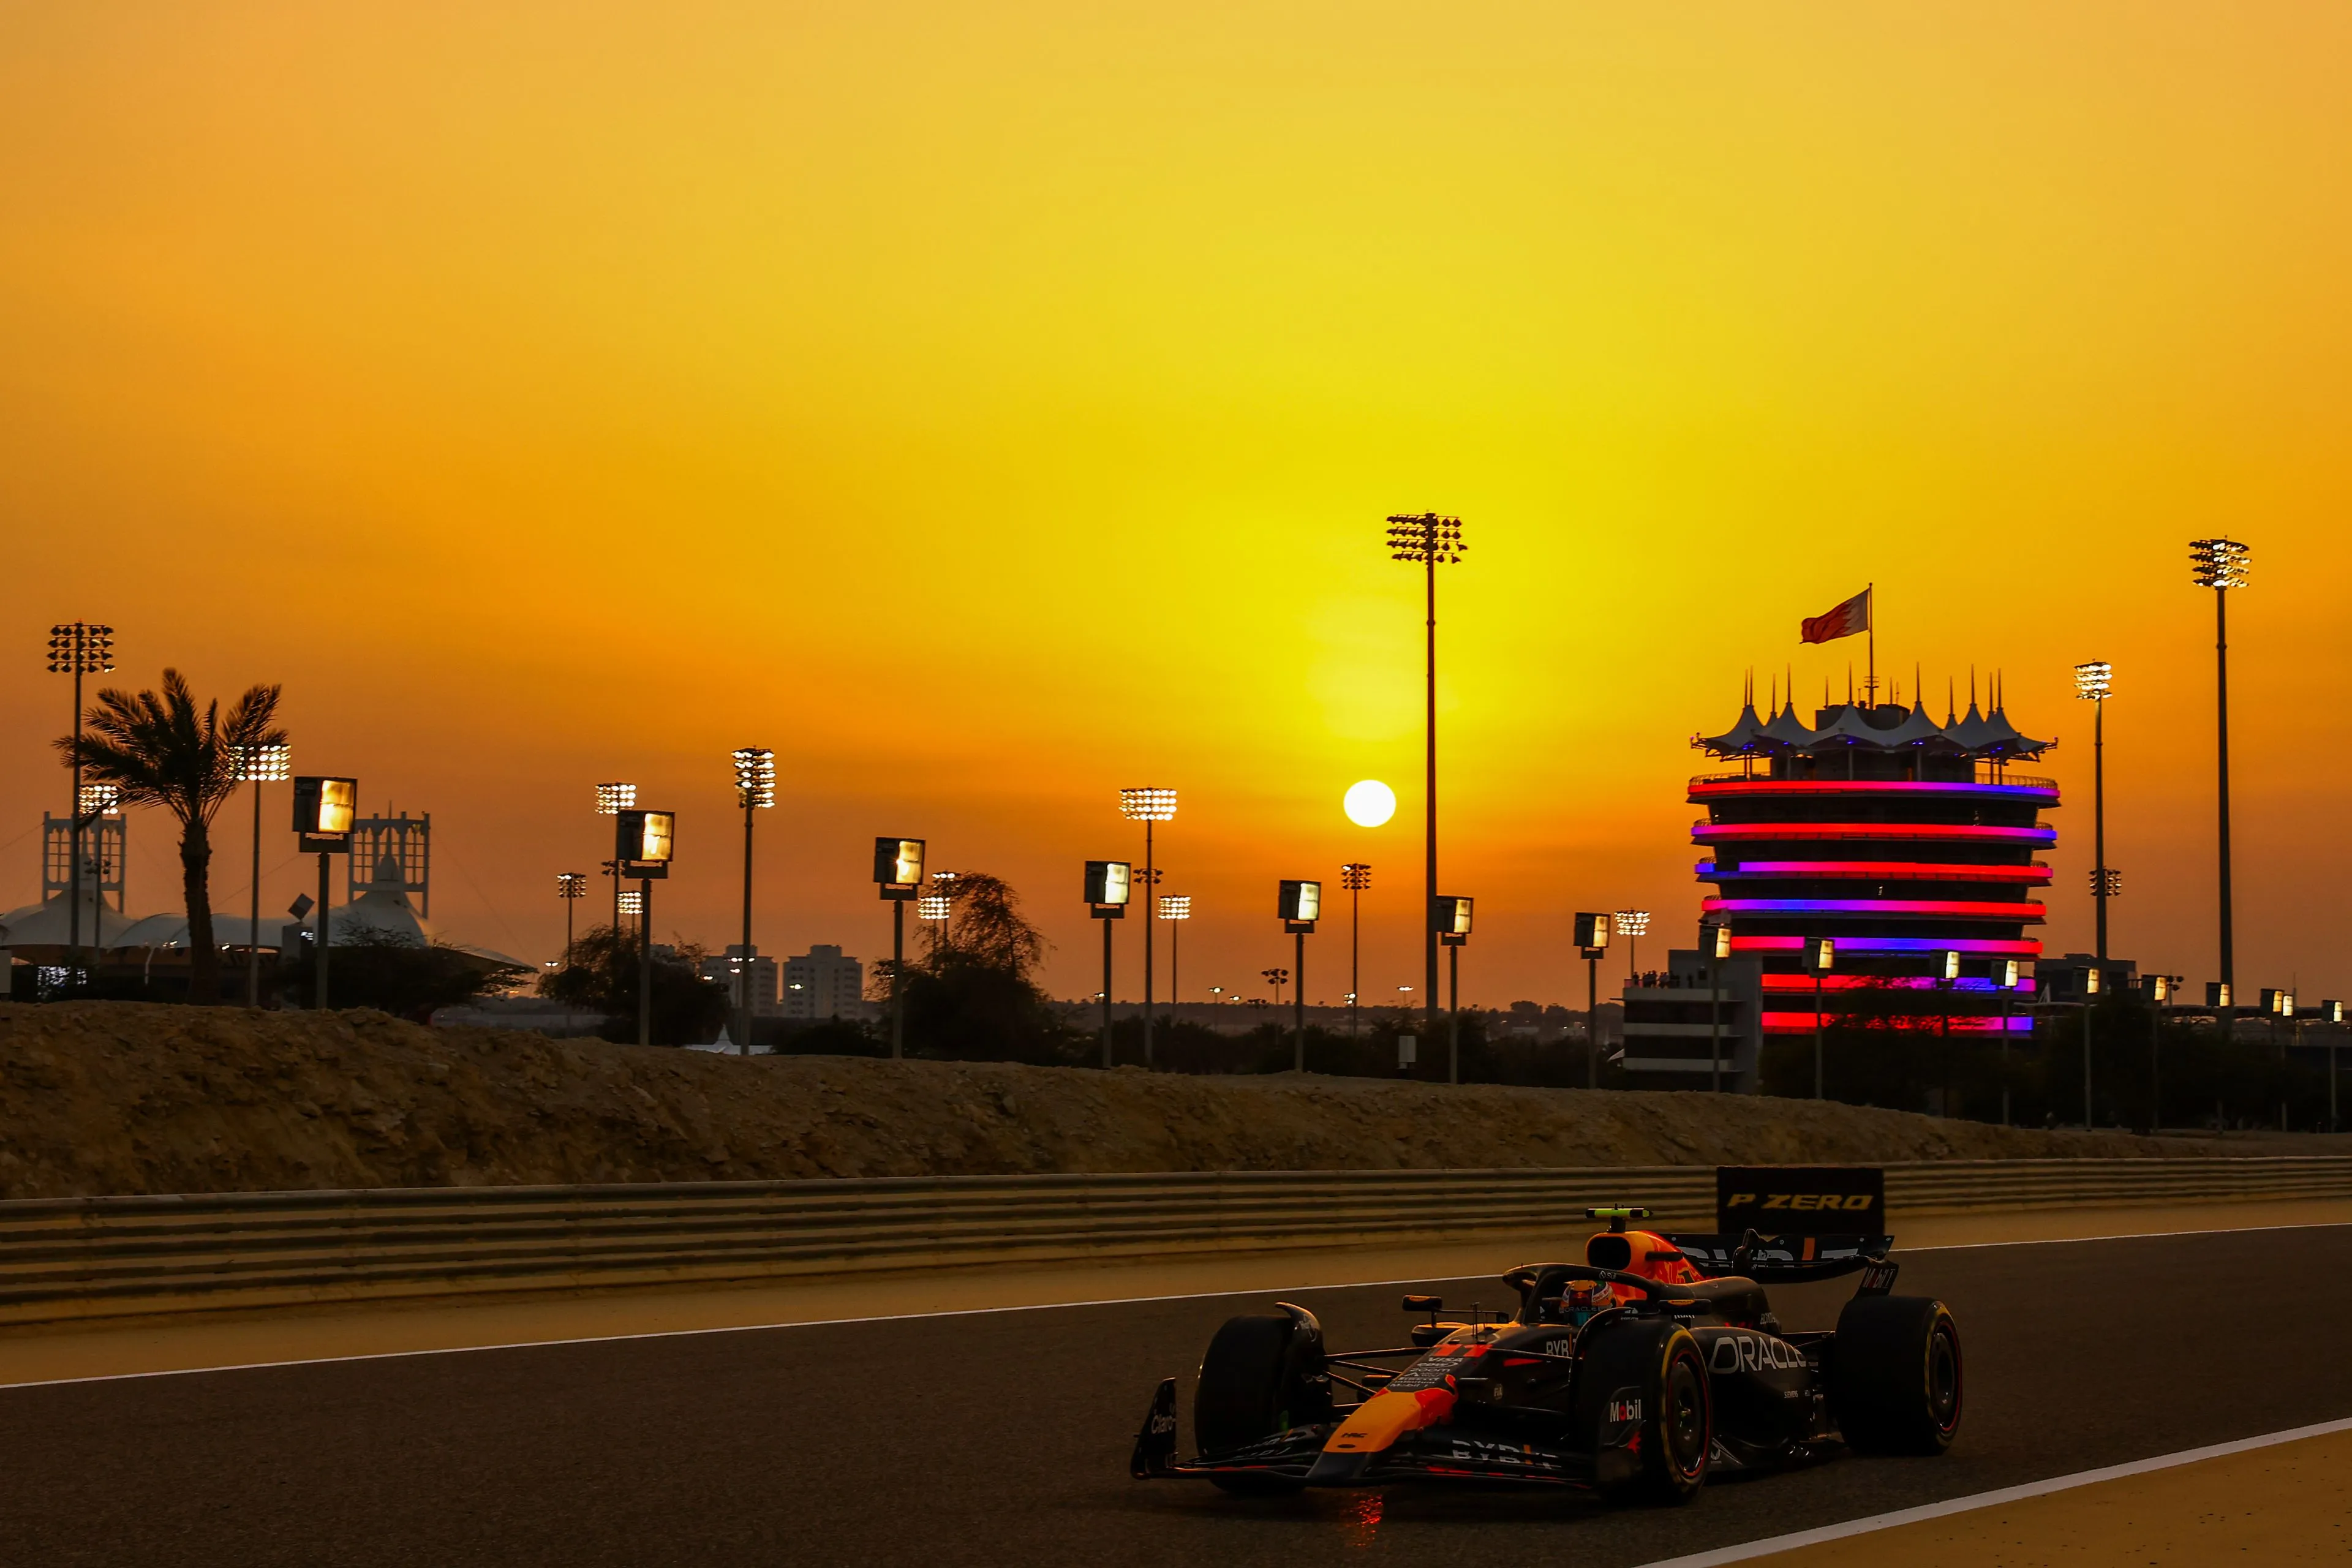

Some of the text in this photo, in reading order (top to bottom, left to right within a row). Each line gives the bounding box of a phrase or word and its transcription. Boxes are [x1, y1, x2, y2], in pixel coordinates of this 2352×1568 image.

[1727, 1193, 1875, 1211] P ZERO
[1545, 1332, 1577, 1357] BYBI
[1609, 1399, 1642, 1423] Mobil
[1152, 1414, 1174, 1435] Claro
